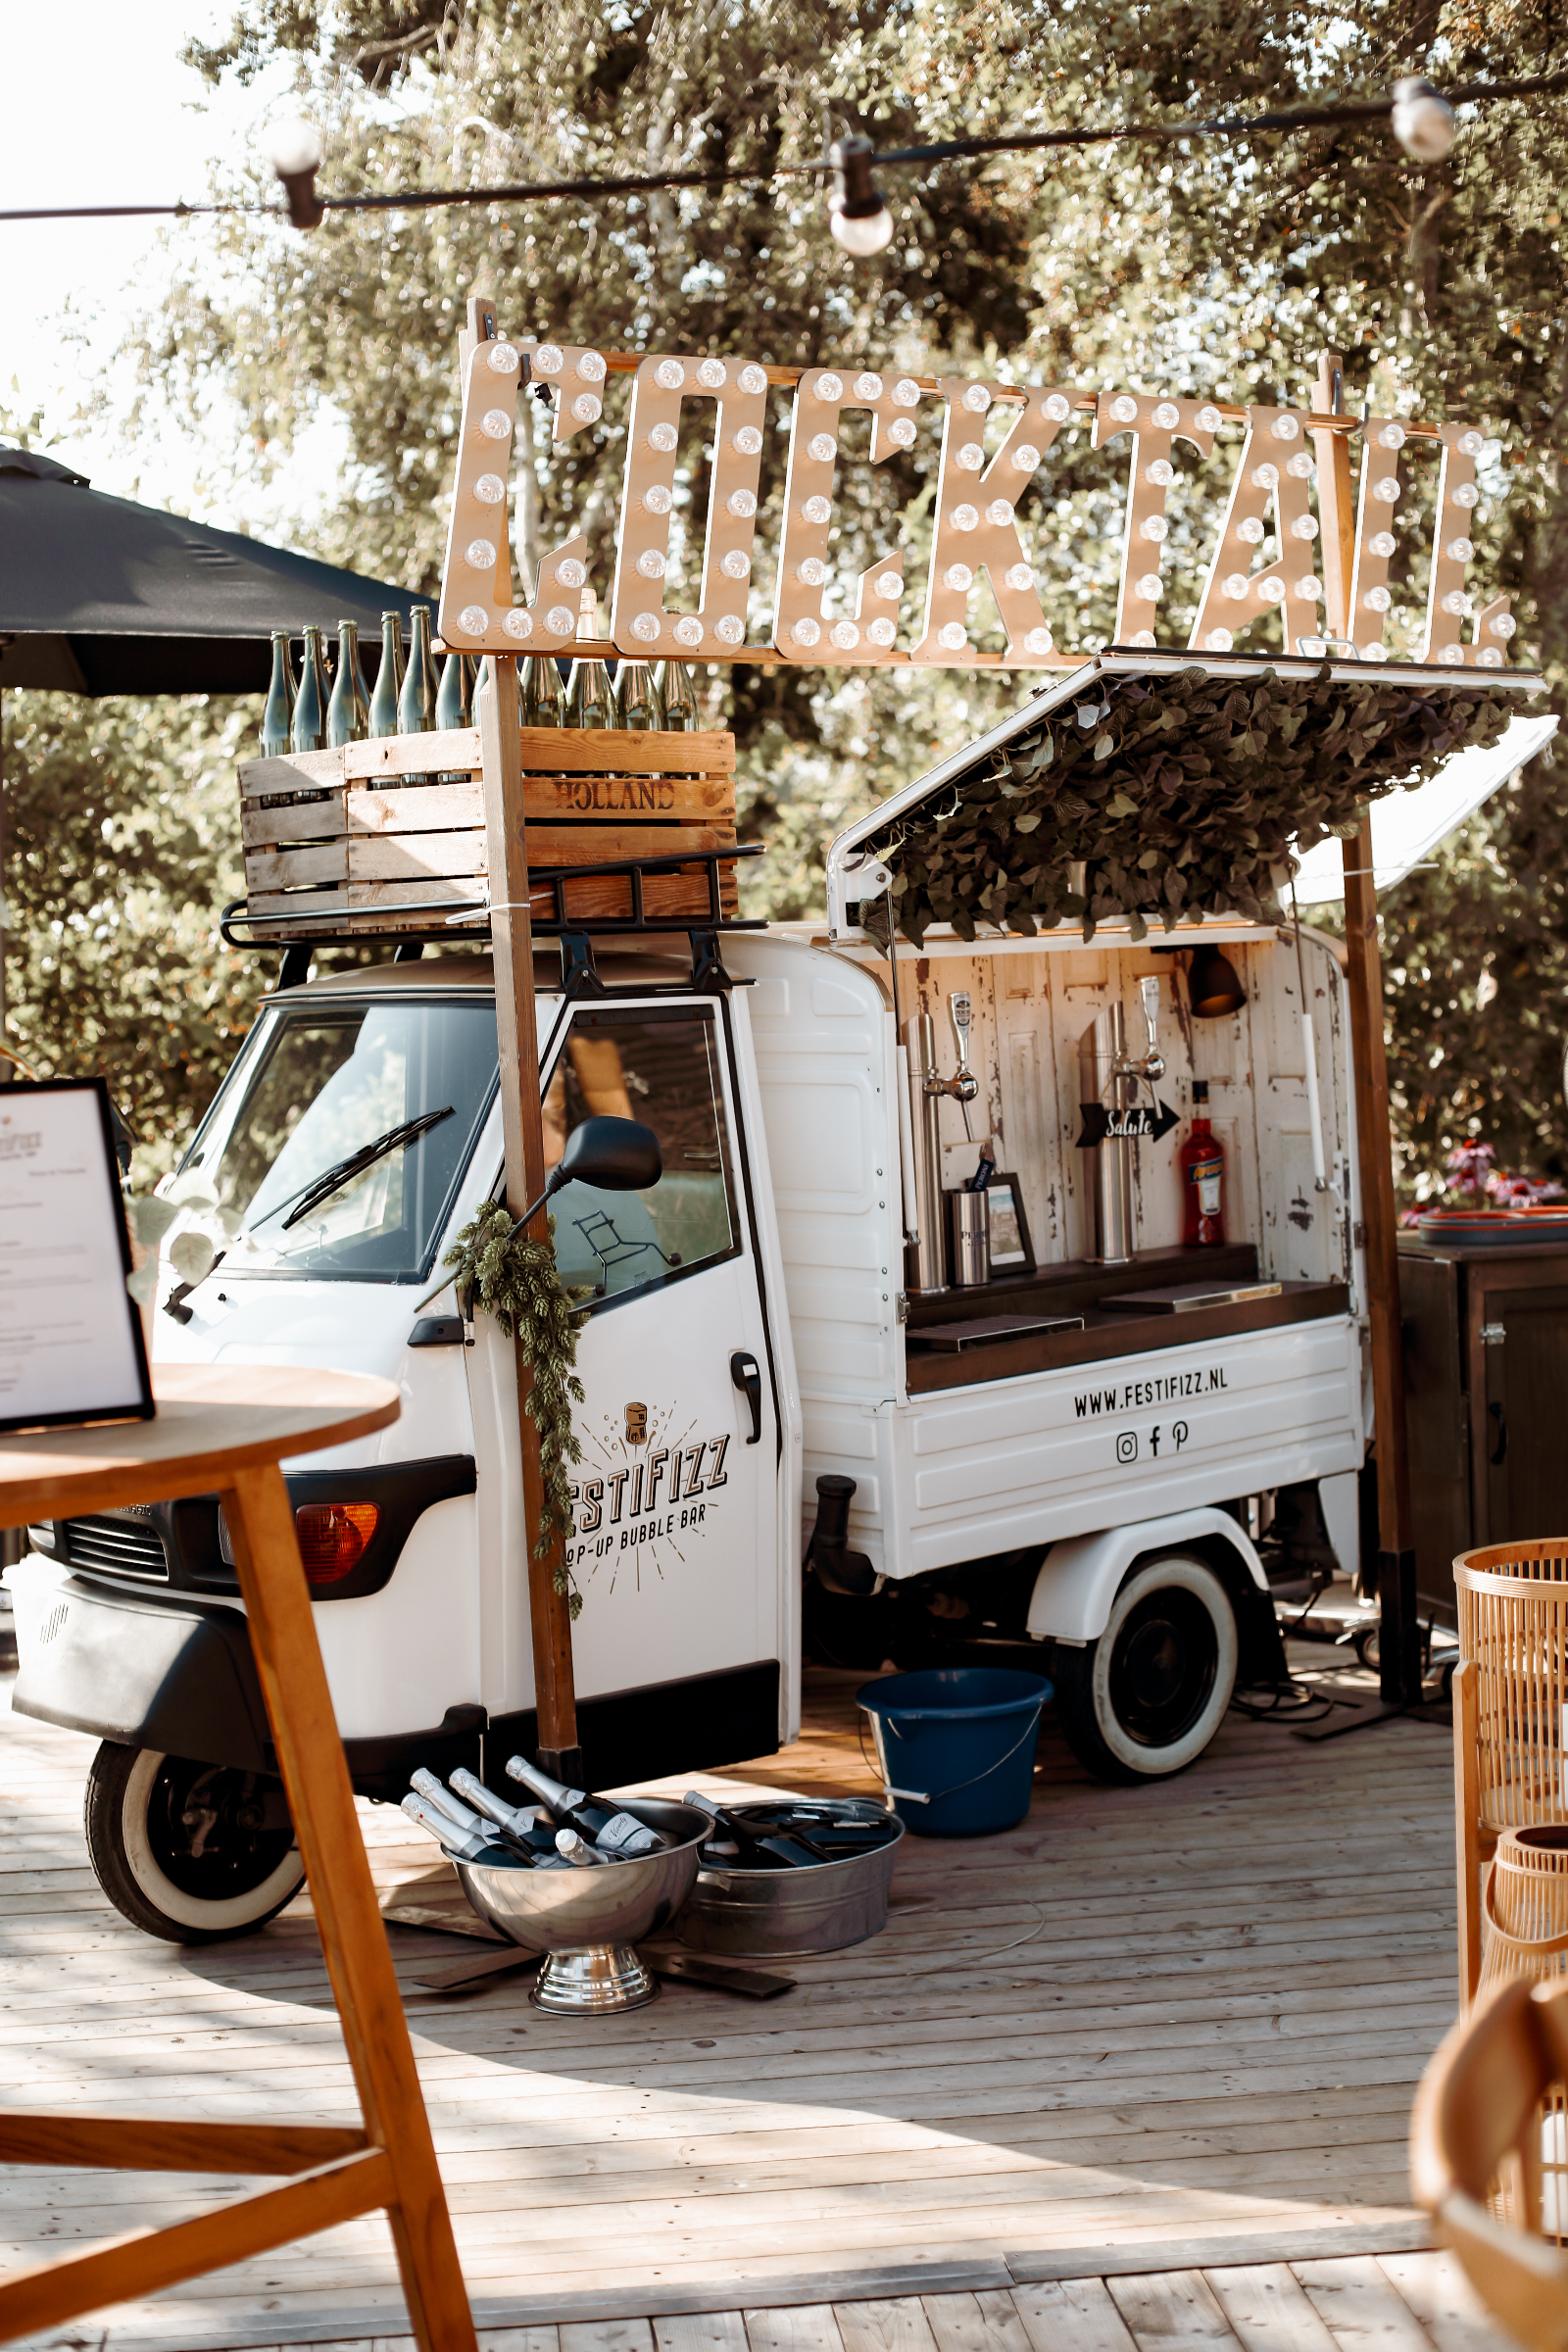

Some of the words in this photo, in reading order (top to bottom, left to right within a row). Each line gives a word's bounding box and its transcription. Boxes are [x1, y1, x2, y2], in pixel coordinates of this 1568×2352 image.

[437, 338, 1511, 665] COCKTAIL
[553, 781, 674, 809] HOLLAND
[1105, 1109, 1152, 1137] Salute
[1193, 1162, 1222, 1180] APERO
[1074, 1367, 1228, 1418] WWW.FESTIFIZZ.NL
[620, 1514, 674, 1550] BUBBLE
[680, 1503, 706, 1529] BAR
